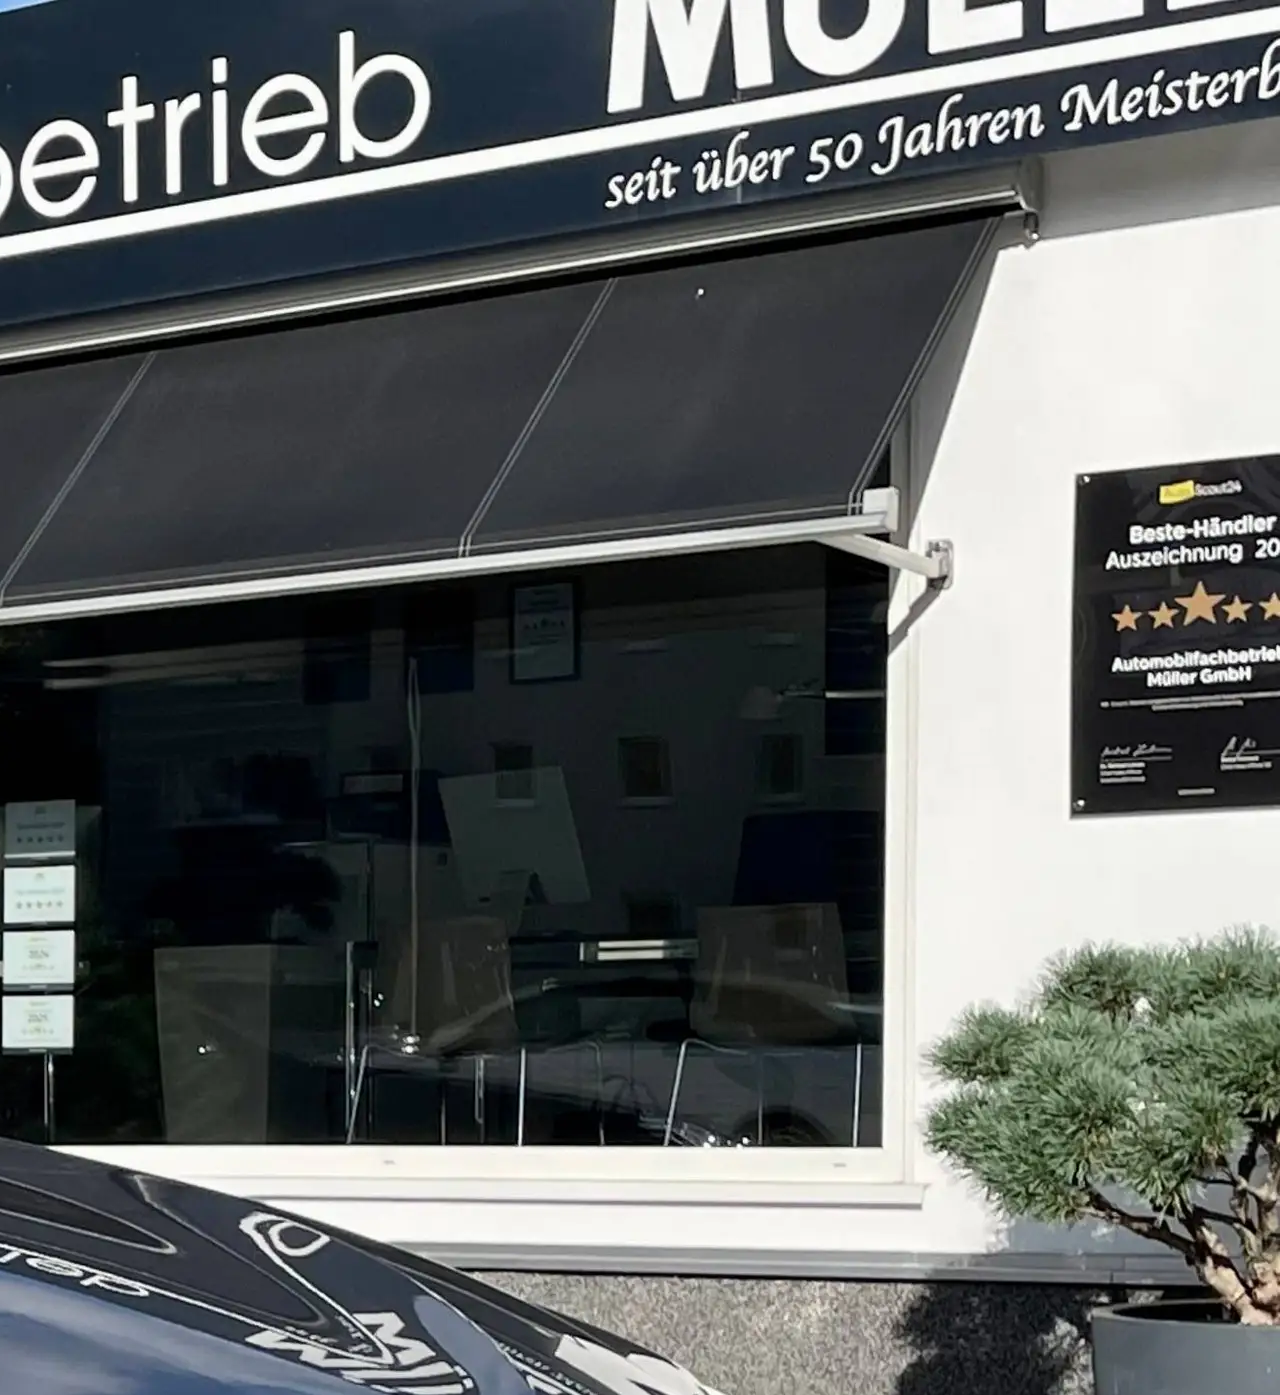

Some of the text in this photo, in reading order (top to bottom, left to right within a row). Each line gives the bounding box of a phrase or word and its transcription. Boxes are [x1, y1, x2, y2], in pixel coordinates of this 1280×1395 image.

[605, 155, 681, 209] seit
[693, 132, 794, 196] über
[806, 133, 863, 183] 50
[871, 95, 1044, 176] Jahren
[1129, 514, 1278, 545] Beste-Händler
[1105, 543, 1244, 571] Auszeichnung
[1112, 645, 1280, 672] Automobilfachbetrie
[1147, 666, 1252, 687] Müller GmbH
